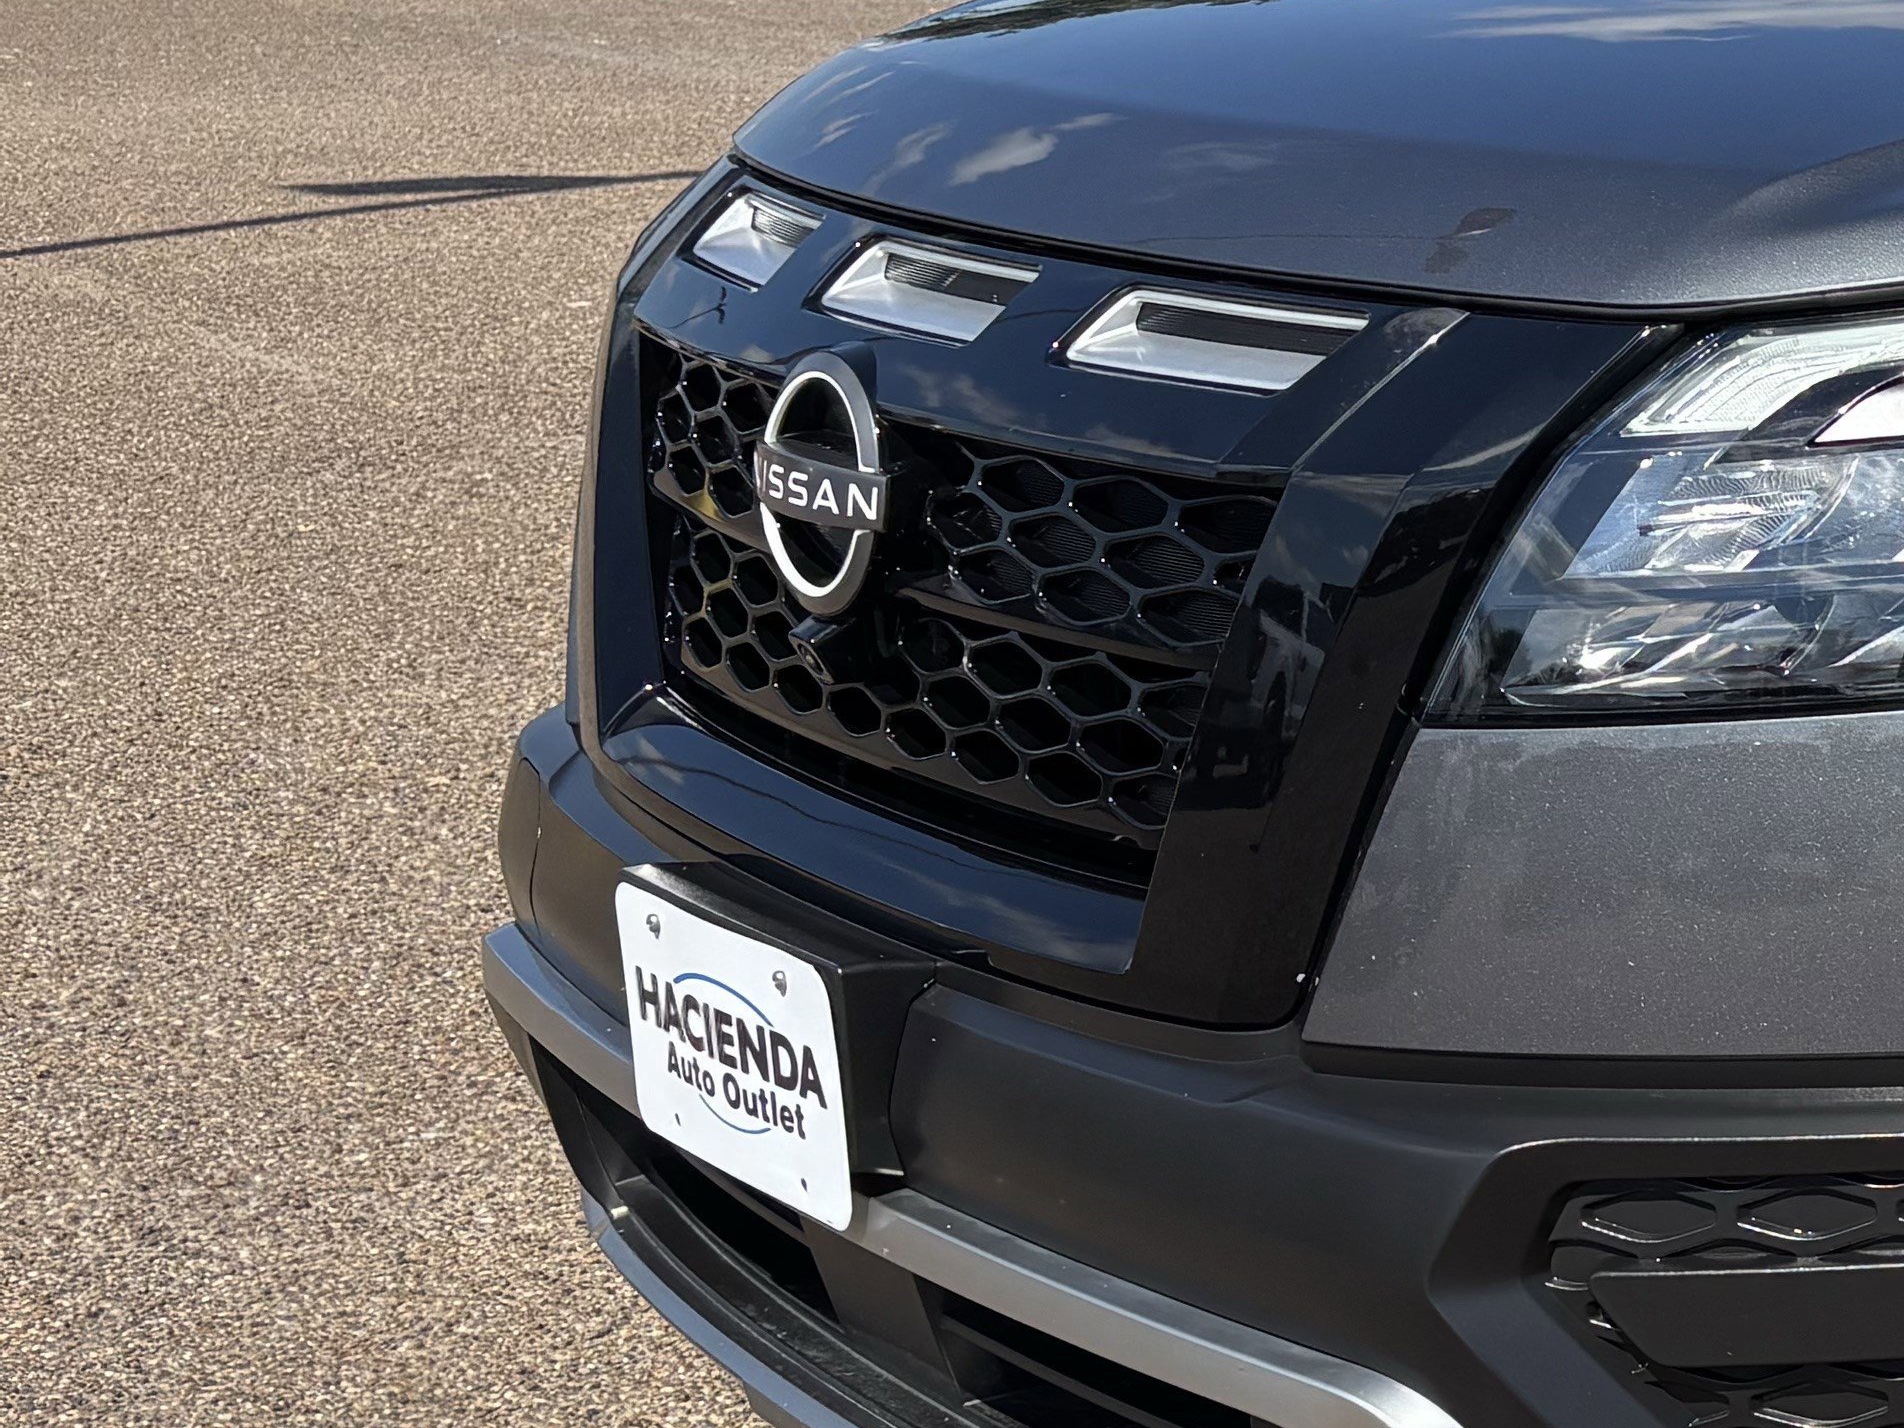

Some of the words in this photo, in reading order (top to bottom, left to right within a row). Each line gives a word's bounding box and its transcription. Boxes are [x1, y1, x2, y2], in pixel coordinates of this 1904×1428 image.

[633, 965, 828, 1110] HACIENDA
[666, 1041, 716, 1098] Auto
[722, 1072, 808, 1141] Outlet
